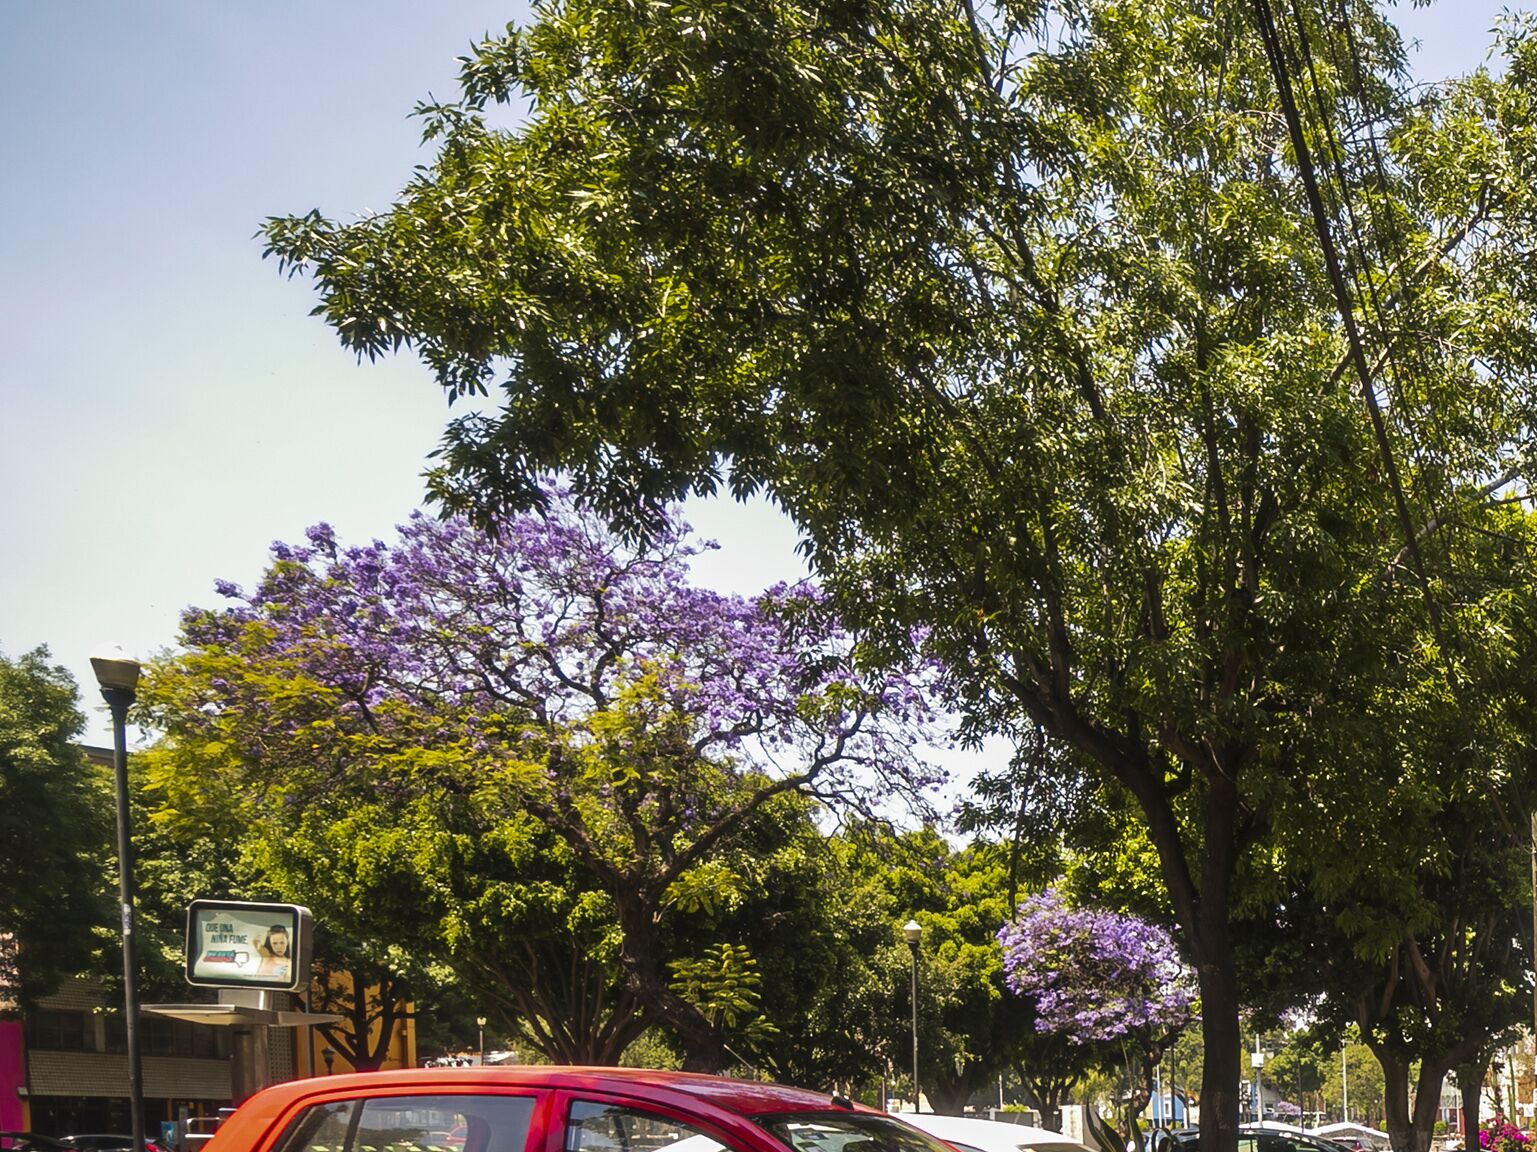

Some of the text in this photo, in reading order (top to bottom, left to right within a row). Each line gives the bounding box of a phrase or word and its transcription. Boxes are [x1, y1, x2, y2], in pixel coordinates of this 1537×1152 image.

[205, 923, 233, 933] QUE UNA
[210, 933, 248, 945] NIÑA FUME
